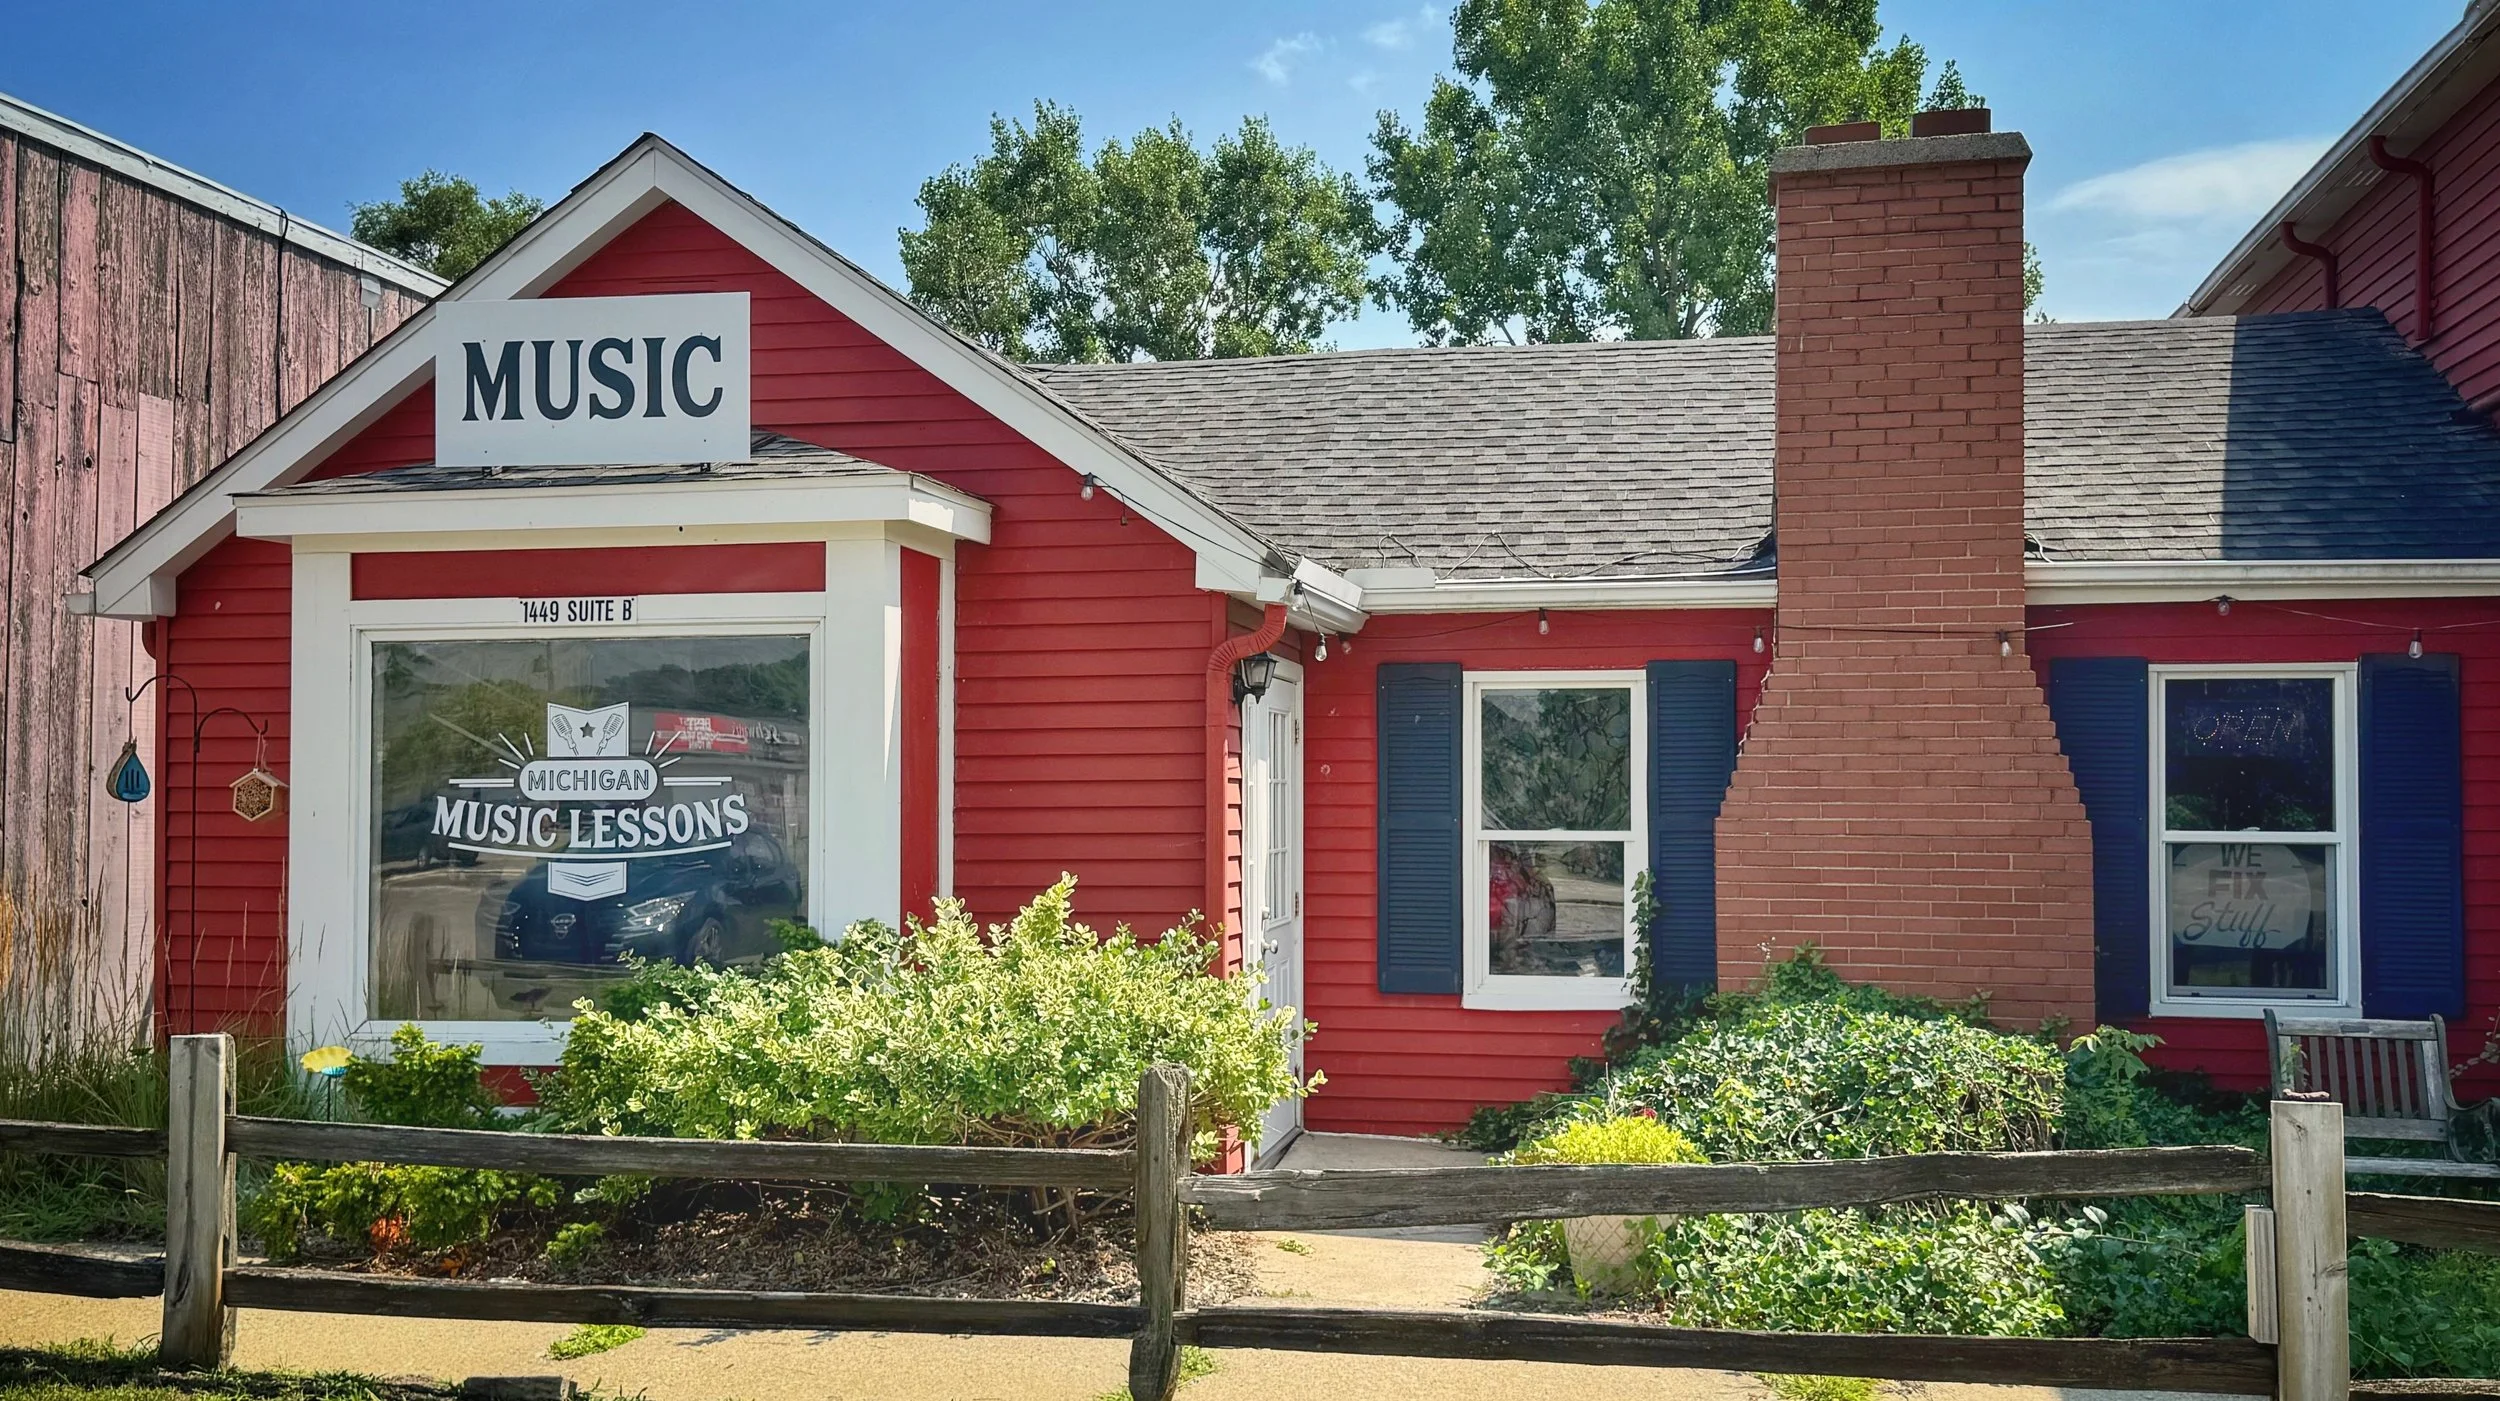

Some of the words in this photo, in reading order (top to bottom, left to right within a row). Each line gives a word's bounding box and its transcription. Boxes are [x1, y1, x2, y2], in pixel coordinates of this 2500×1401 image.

[461, 335, 724, 421] MUSIC
[523, 600, 559, 623] 1449
[567, 599, 614, 622] SUITE
[622, 599, 632, 621] B
[2193, 712, 2297, 741] OPEN
[527, 769, 650, 791] MICHIGAN
[431, 795, 558, 847] MUSIC
[567, 792, 750, 849] LESSONS
[2221, 844, 2262, 868] WE
[2208, 869, 2268, 900] FIX
[2183, 901, 2281, 948] Stuff
